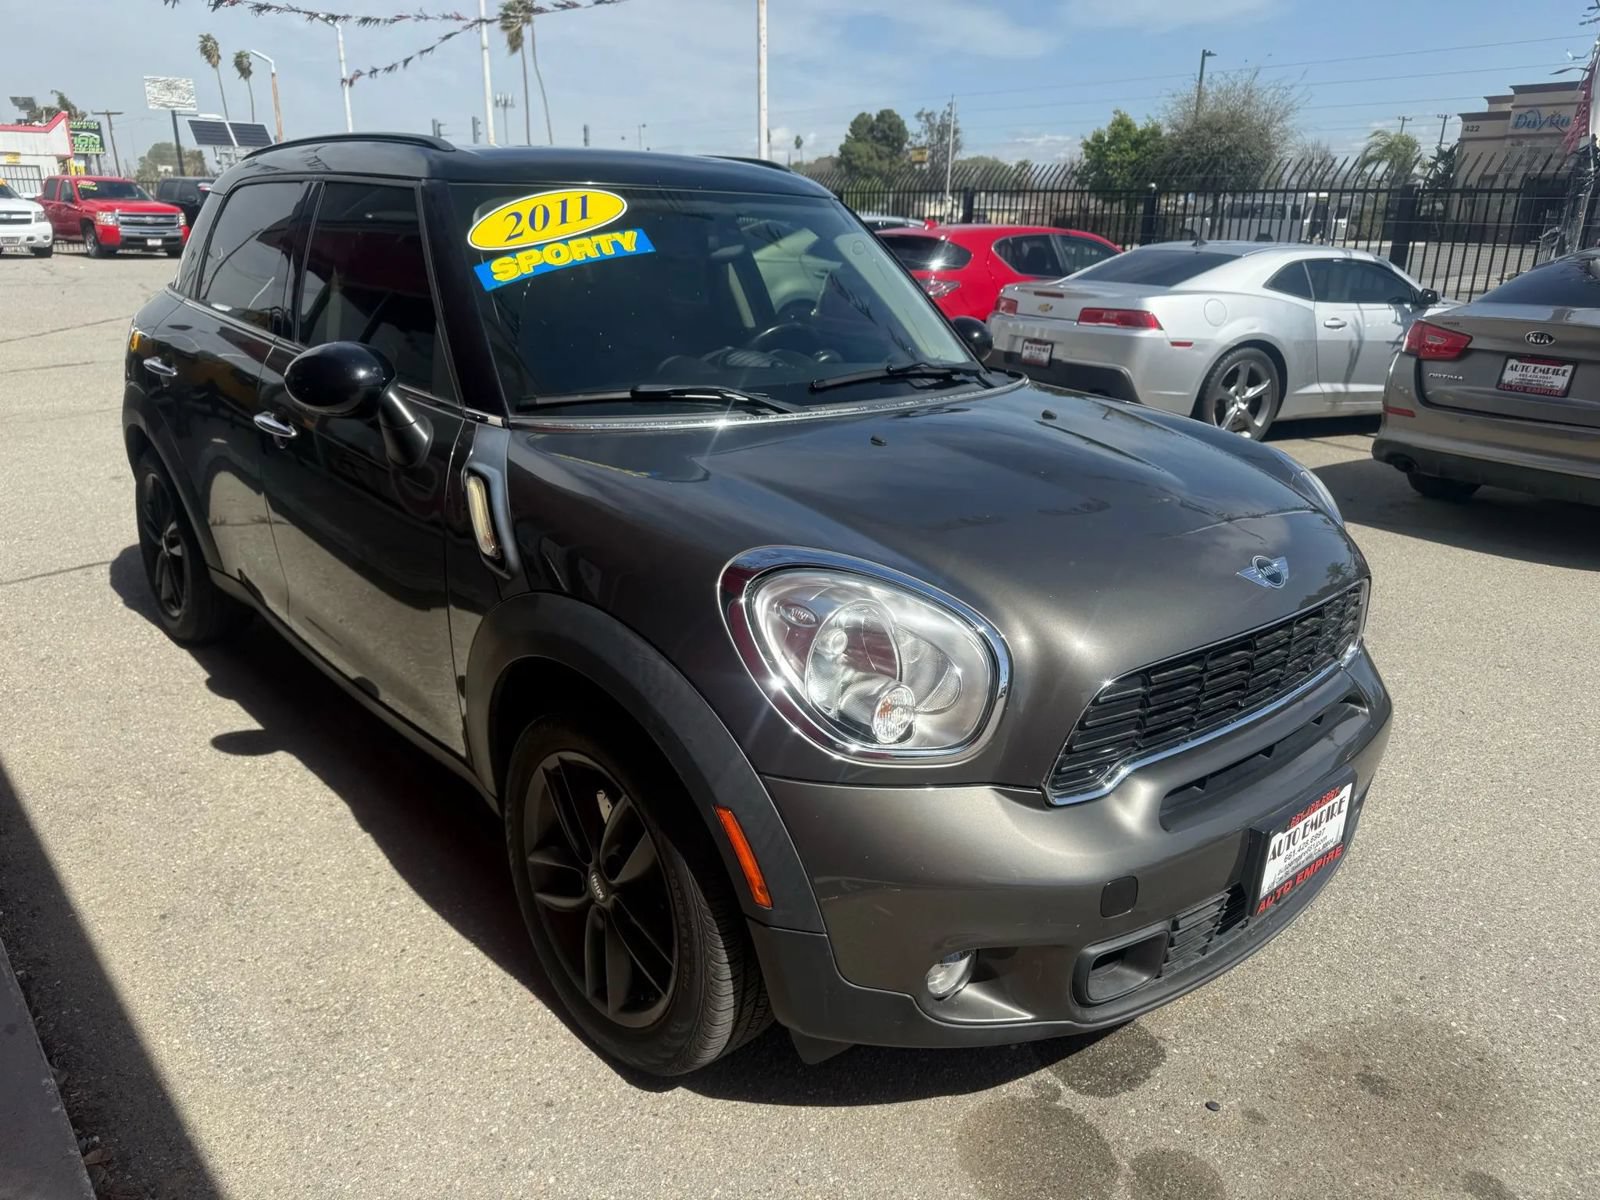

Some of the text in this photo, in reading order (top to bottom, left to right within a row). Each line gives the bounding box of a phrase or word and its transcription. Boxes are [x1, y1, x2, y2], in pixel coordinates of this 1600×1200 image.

[503, 194, 592, 243] 2011
[490, 230, 637, 282] SPORTY
[1528, 332, 1550, 344] KIA
[1508, 363, 1531, 373] AUTO
[1532, 365, 1569, 377] EMPIRE
[1268, 827, 1300, 863] AUTO
[1302, 796, 1346, 840] EMPIRE
[591, 874, 604, 899] MINI
[1256, 879, 1293, 916] AUTO
[1295, 844, 1343, 886] EMPIRE
